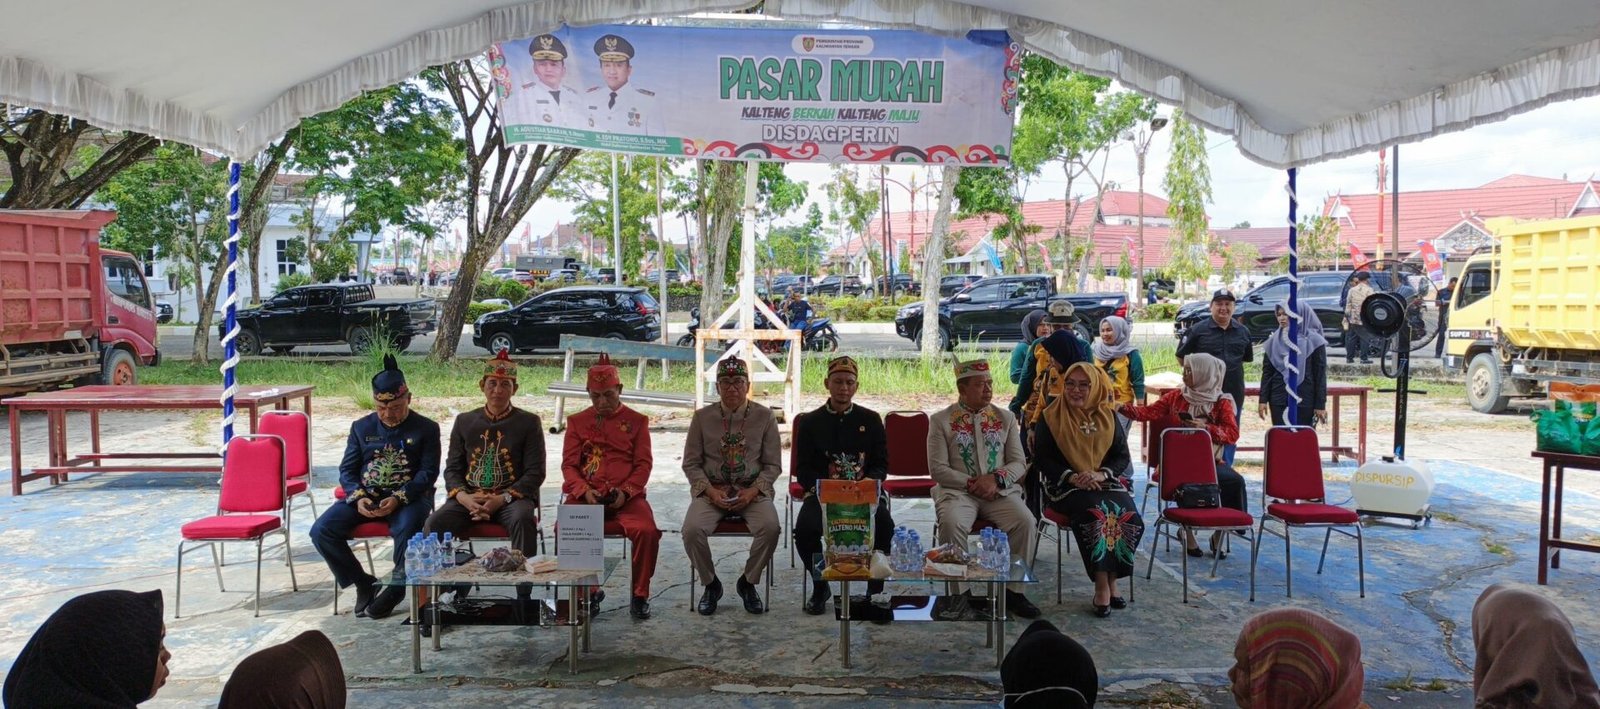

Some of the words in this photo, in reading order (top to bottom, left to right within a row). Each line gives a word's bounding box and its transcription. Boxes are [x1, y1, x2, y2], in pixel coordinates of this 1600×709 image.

[719, 57, 823, 102] PASAR
[829, 58, 944, 104] MURAH
[741, 107, 790, 119] KALTENG
[792, 108, 835, 119] BERKAH
[837, 108, 886, 121] KALTENG
[888, 109, 920, 121] MAJU
[762, 124, 899, 144] DISDAGPERIN
[1355, 471, 1414, 488] DISPURSIP
